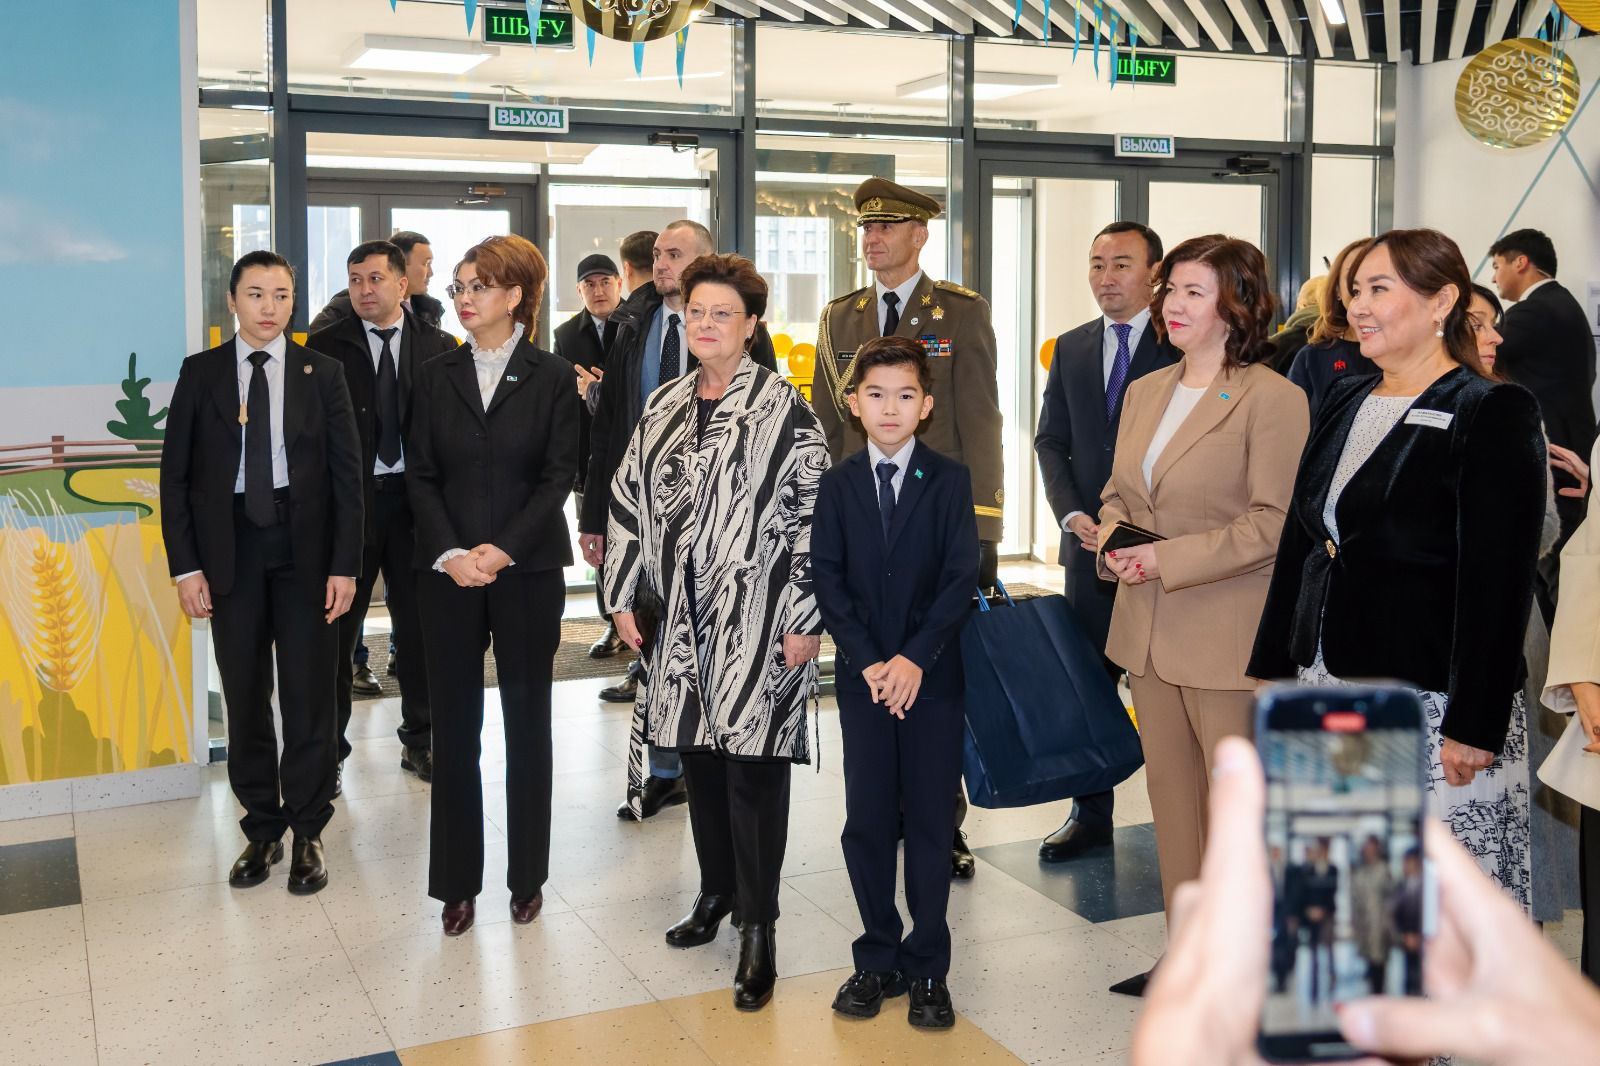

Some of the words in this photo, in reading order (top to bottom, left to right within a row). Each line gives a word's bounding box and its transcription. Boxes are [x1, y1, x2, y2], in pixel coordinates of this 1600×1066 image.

[1117, 58, 1171, 77] ШЫҒУ
[497, 109, 561, 128] ВЫХОД
[1122, 138, 1169, 153] ВЫХОД
